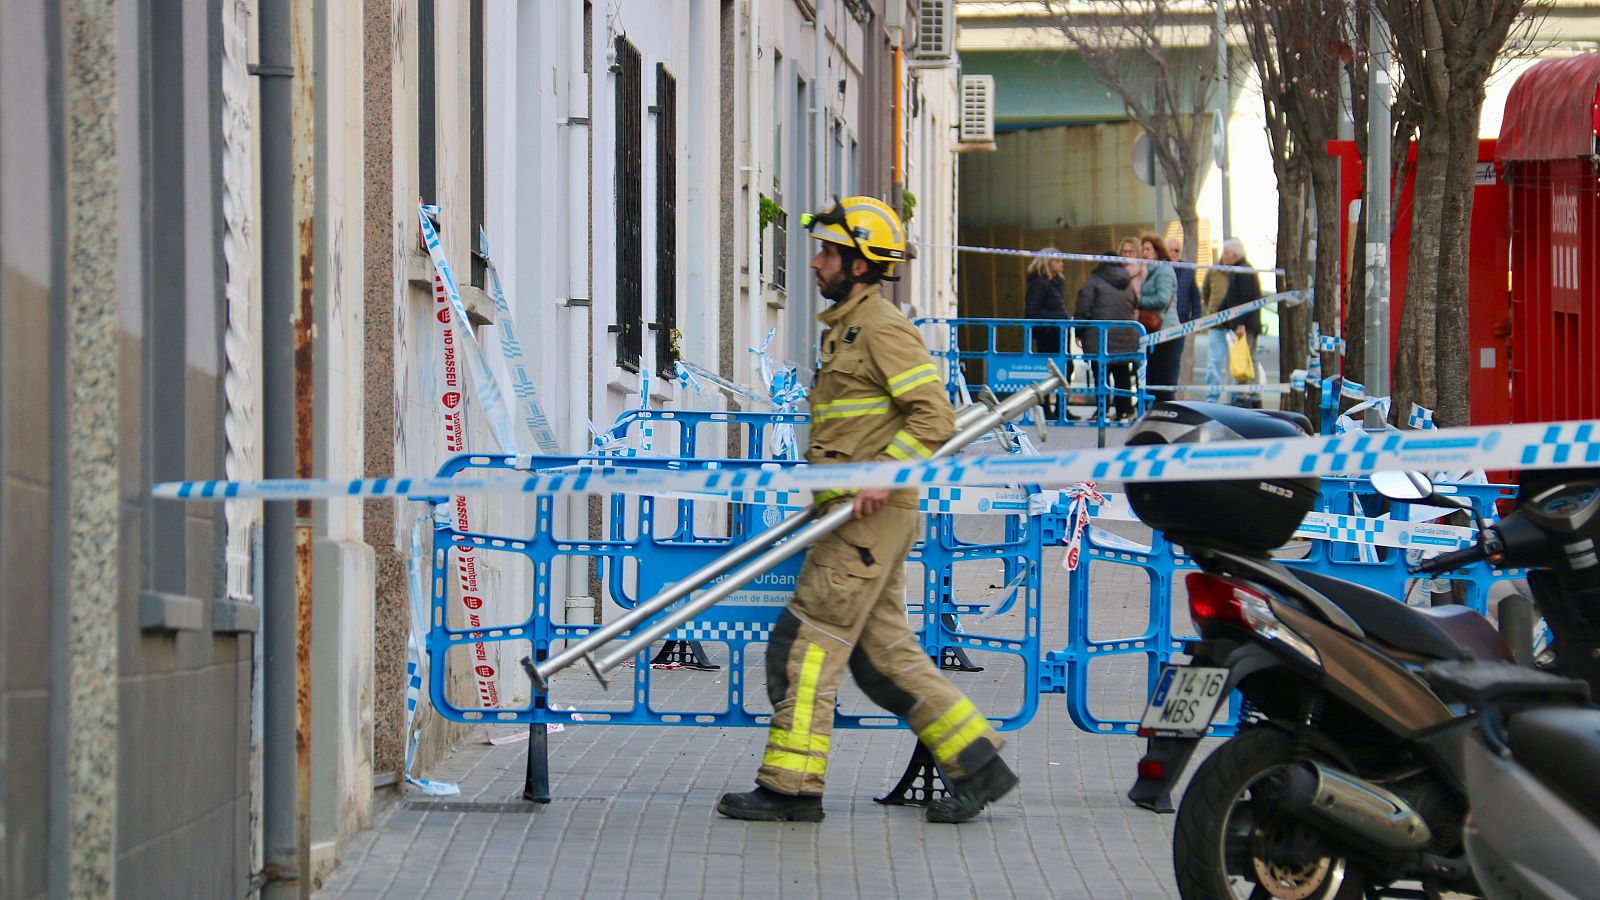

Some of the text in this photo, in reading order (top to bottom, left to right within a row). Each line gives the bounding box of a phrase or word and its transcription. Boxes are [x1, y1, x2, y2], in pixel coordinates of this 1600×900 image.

[443, 329, 457, 387] NO PASSEU
[449, 393, 458, 406] 112
[453, 410, 463, 452] bombers
[456, 494, 469, 532] PASSEU
[466, 556, 479, 593] bombers
[470, 613, 480, 628] NO
[1160, 698, 1200, 724] MBS
